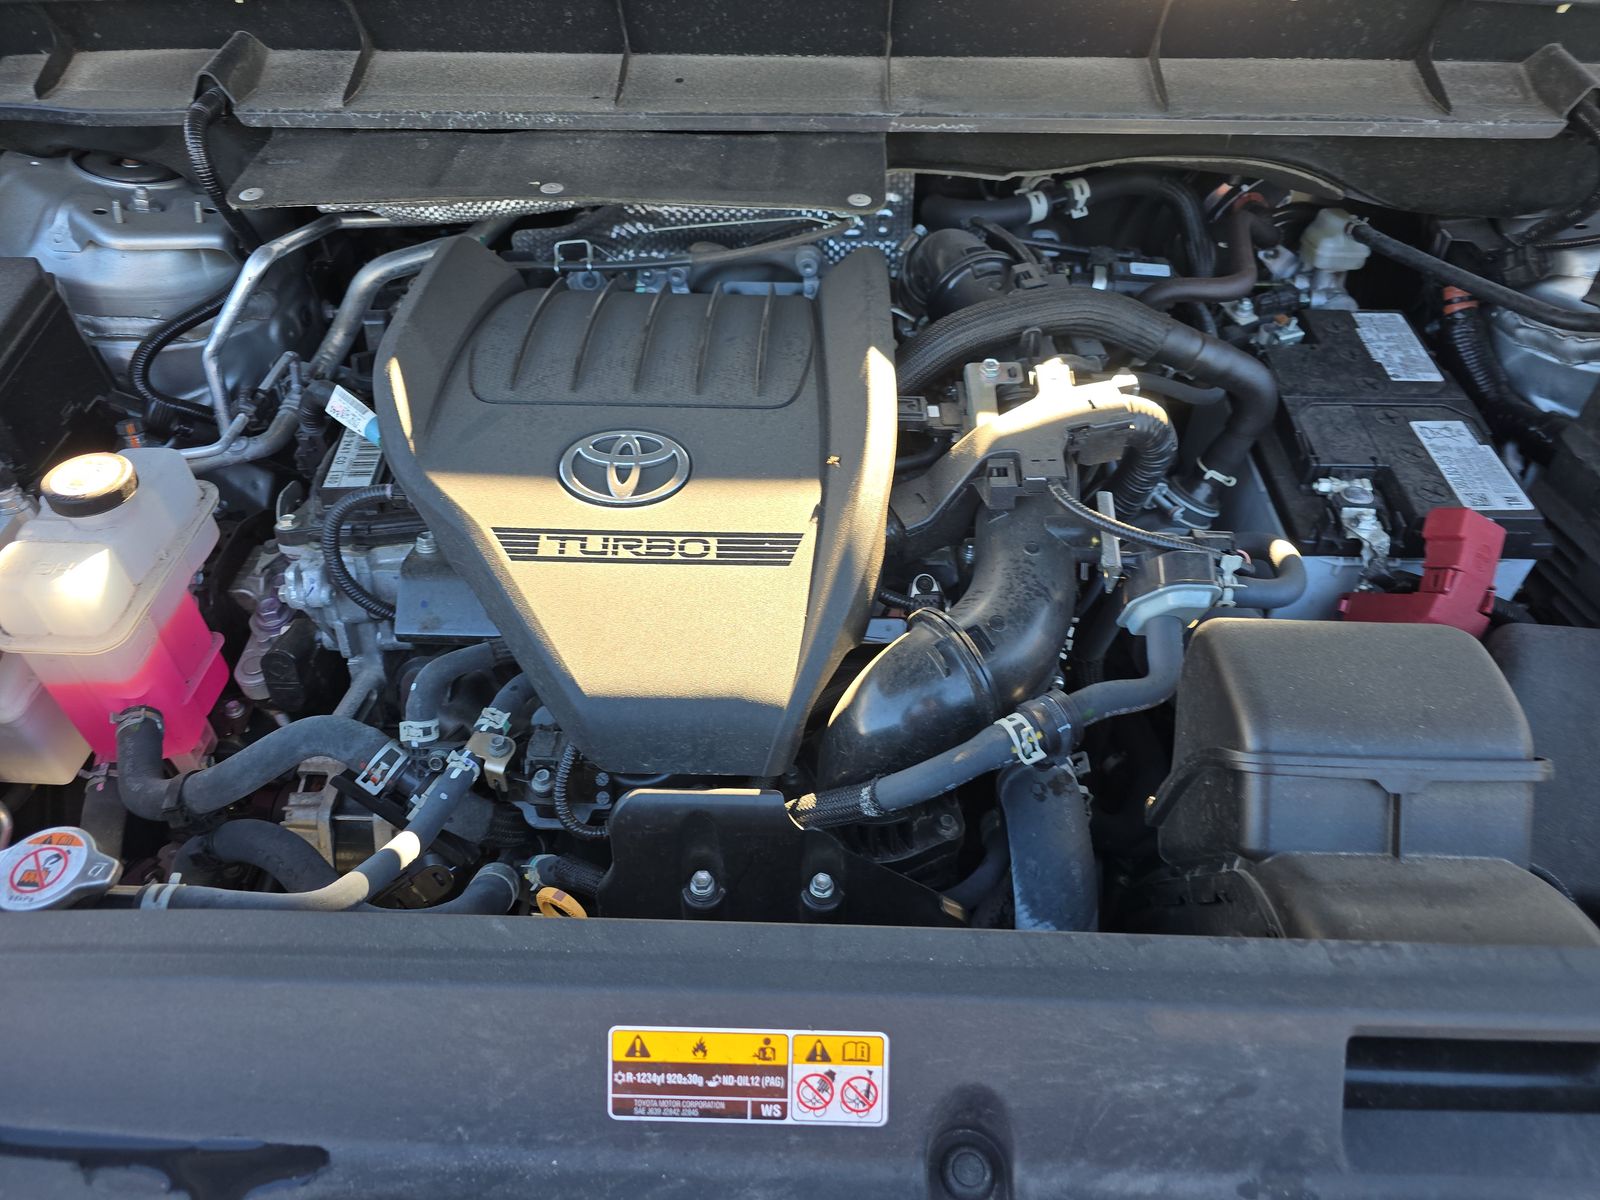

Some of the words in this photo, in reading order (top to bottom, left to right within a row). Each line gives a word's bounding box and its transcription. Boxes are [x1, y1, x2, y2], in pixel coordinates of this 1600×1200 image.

[546, 535, 713, 559] TURBO
[761, 1076, 785, 1089] (PAG)
[635, 1099, 658, 1107] TOYOTA
[660, 1100, 681, 1108] MOTOR
[682, 1101, 726, 1109] CORPORATION
[760, 1103, 782, 1118] WS
